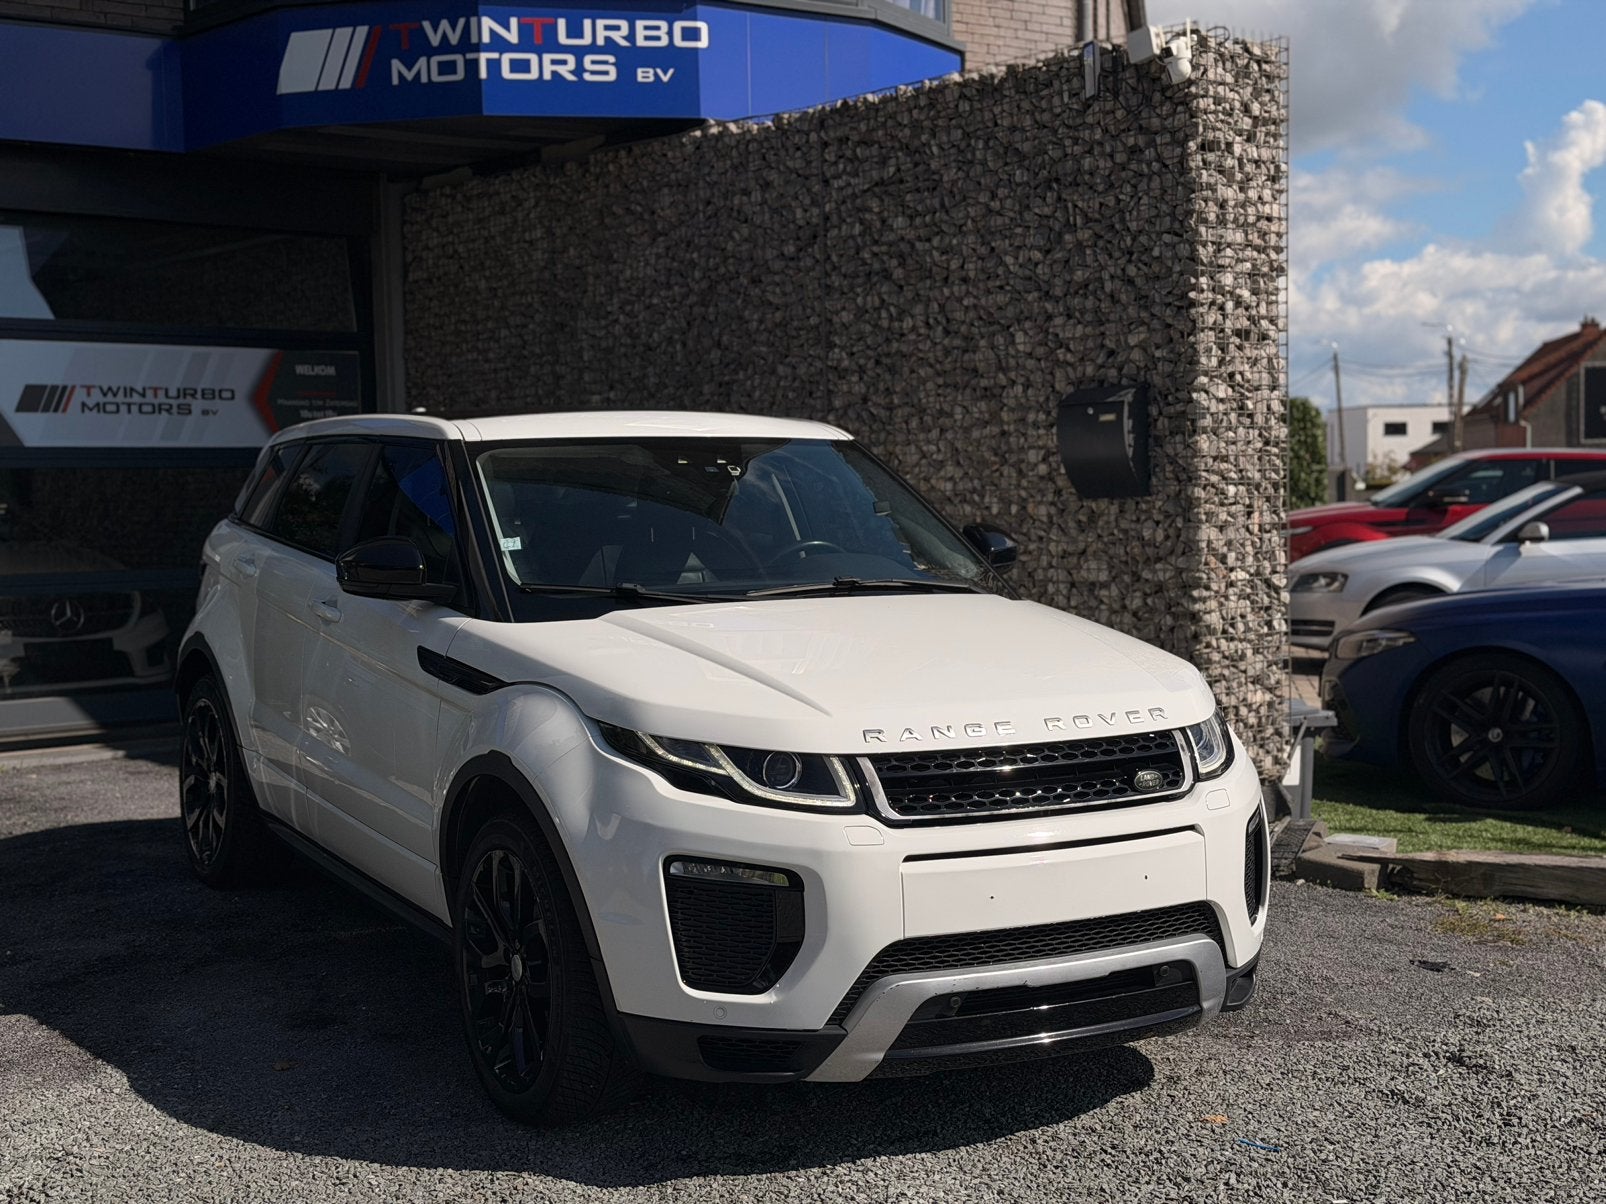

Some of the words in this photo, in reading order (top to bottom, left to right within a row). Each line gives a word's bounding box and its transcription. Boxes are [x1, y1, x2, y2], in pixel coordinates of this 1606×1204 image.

[389, 16, 709, 49] TWINTURBO
[391, 52, 617, 85] MOTORS
[637, 68, 674, 82] BV
[80, 384, 236, 401] TWINTURBO
[81, 401, 192, 416] MOTORS
[201, 408, 219, 416] BV
[862, 720, 1016, 744] RANGE
[1043, 706, 1168, 731] ROVER
